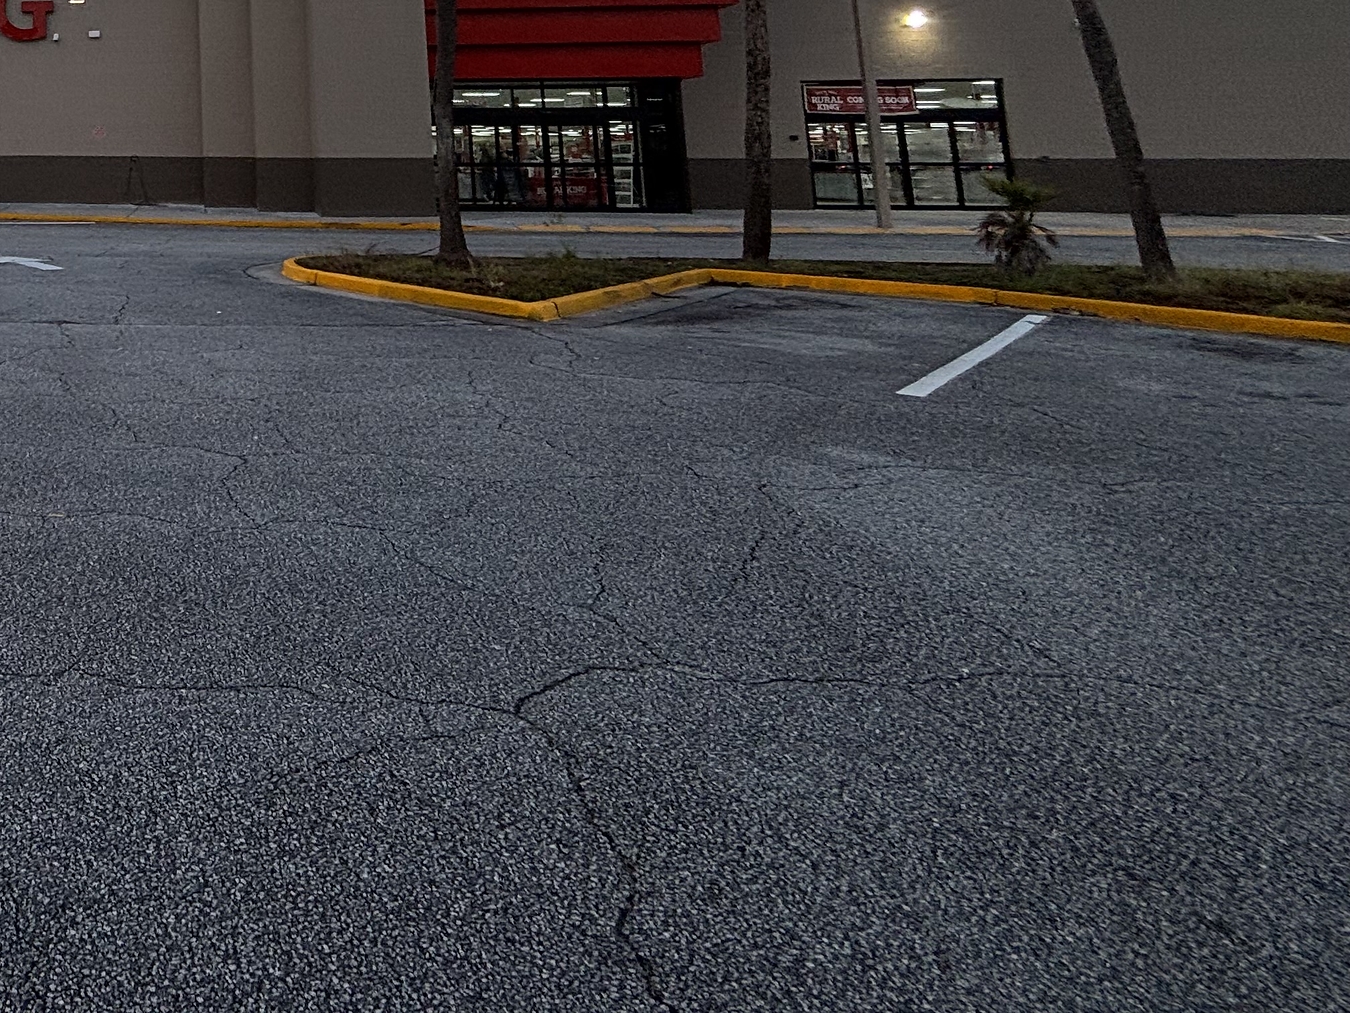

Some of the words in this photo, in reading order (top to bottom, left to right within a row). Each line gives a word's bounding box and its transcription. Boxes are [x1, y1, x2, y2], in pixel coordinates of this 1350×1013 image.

[811, 96, 844, 104] RURAL
[885, 96, 910, 104] SOON
[816, 103, 840, 111] KING
